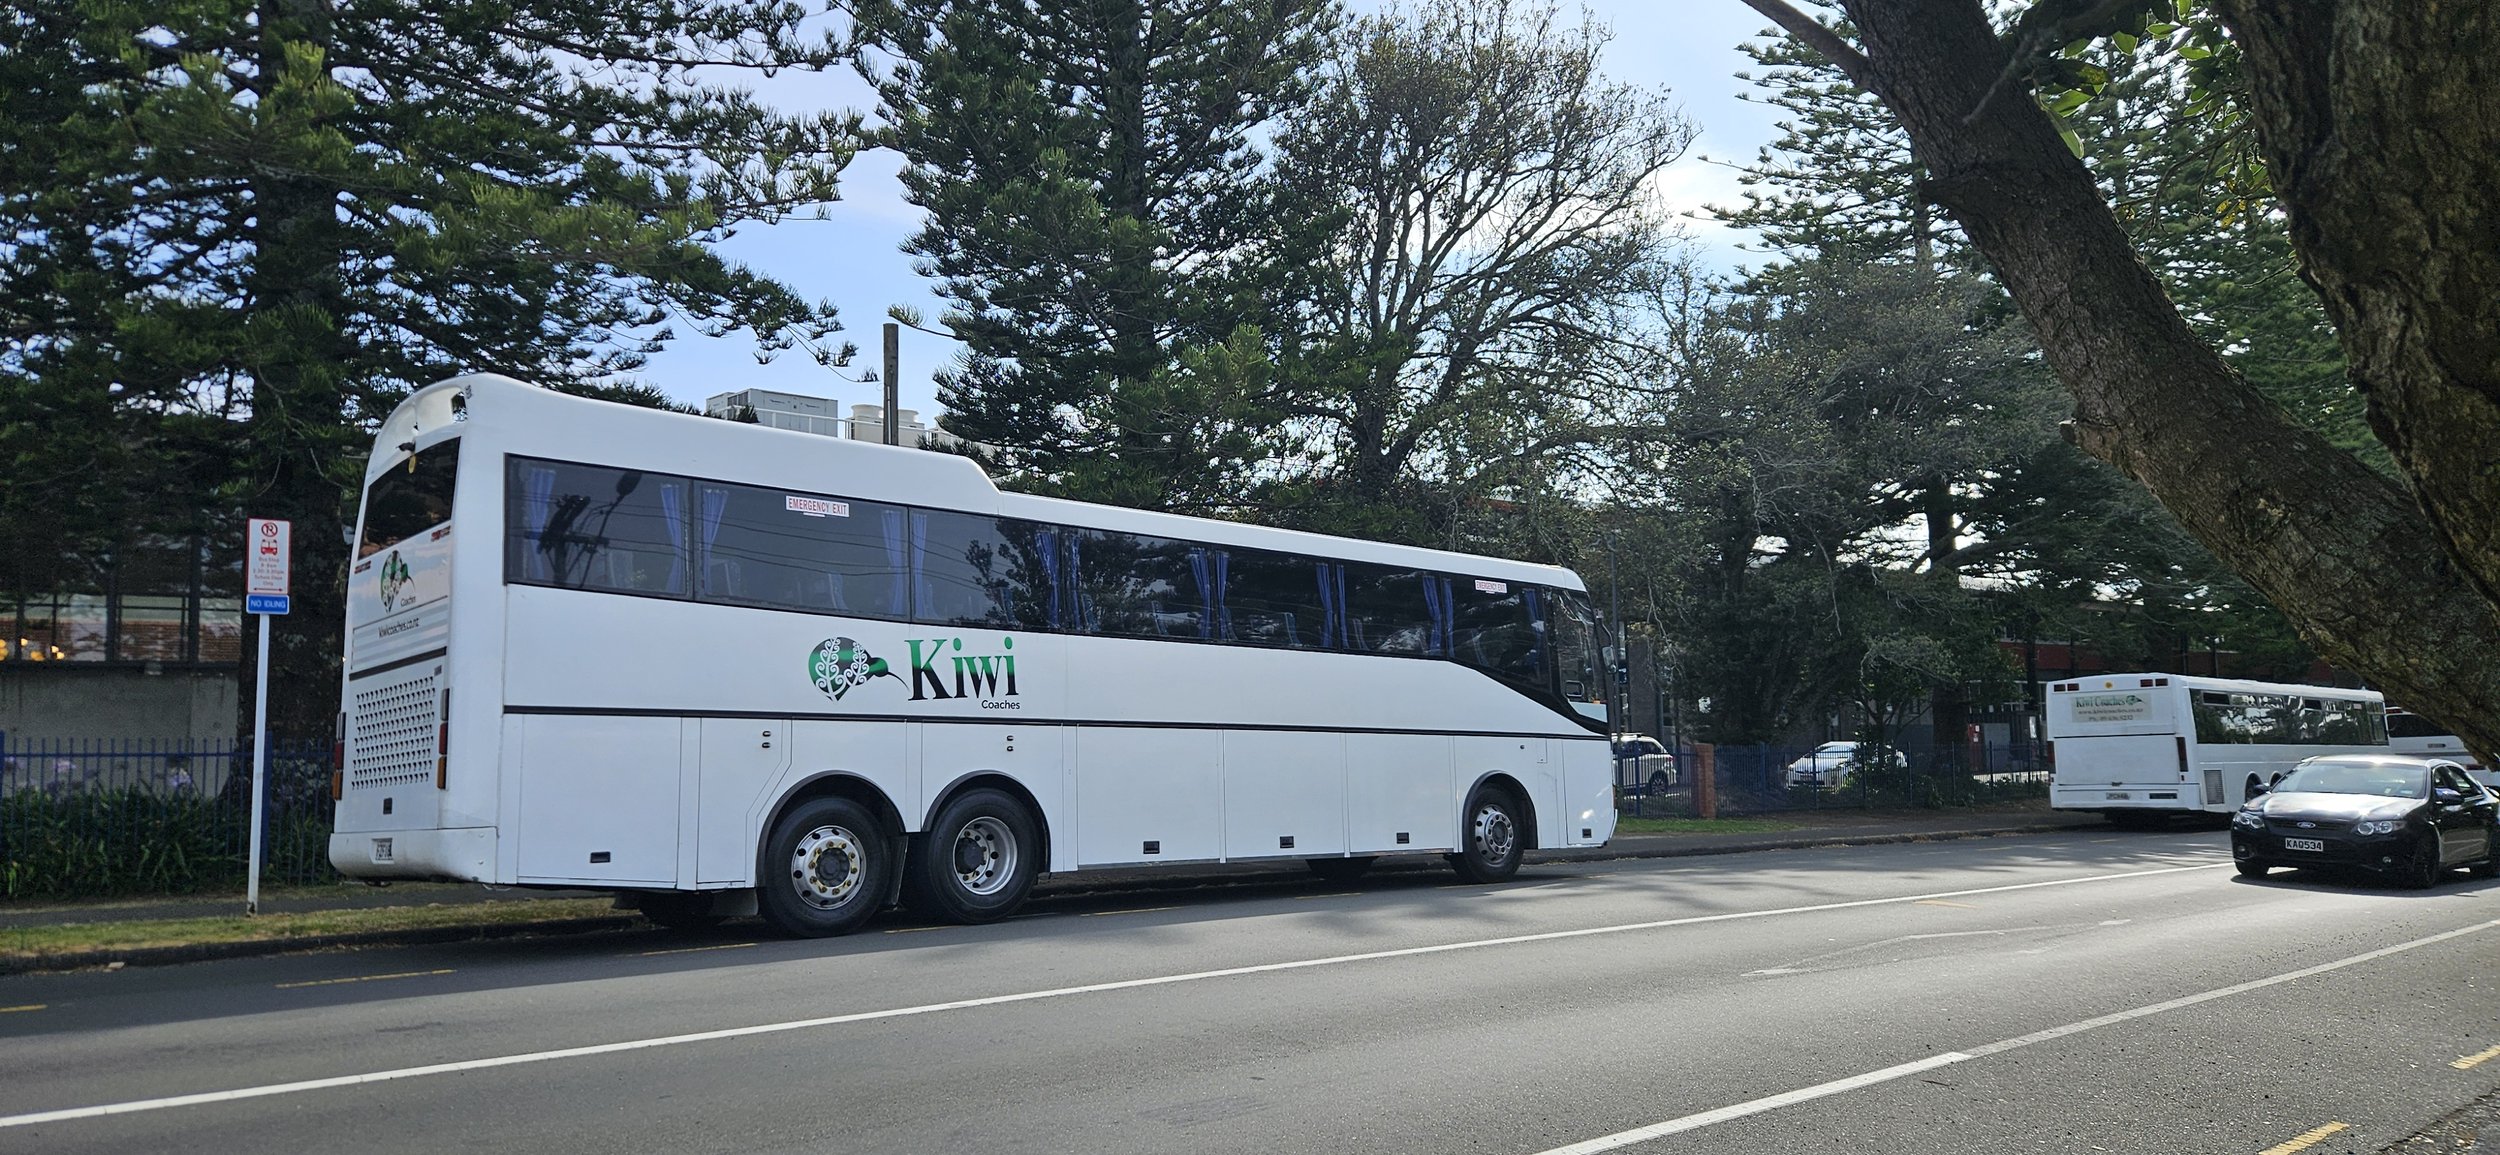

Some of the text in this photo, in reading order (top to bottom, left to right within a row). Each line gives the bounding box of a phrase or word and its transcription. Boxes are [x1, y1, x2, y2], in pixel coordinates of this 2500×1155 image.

[788, 498, 847, 515] EMERGENCY EXIT
[250, 599, 286, 609] NO IDLING
[904, 636, 1019, 701] Kiwi
[981, 699, 1021, 710] Coaches
[2076, 696, 2126, 708] Kiwi Coaches
